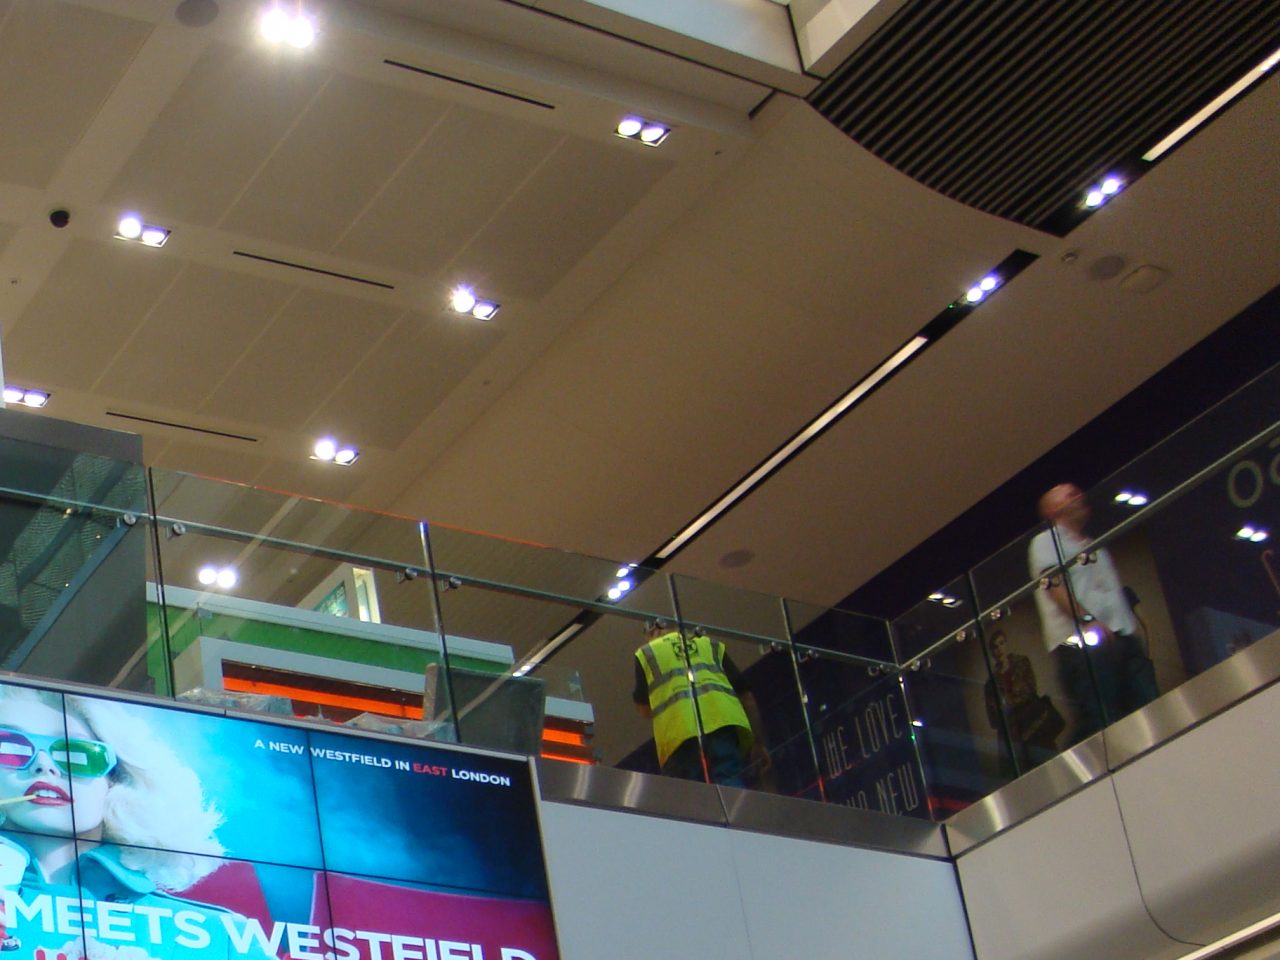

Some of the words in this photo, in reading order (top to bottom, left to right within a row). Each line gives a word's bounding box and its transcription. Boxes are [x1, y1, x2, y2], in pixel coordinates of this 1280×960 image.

[855, 694, 903, 759] LOVE
[254, 739, 265, 749] A
[269, 741, 304, 756] NEW
[310, 747, 392, 768] WESTFIELD
[395, 760, 410, 771] IN
[413, 763, 448, 777] EAST
[451, 768, 511, 787] LONDON
[875, 761, 919, 817] NEW
[4, 889, 211, 949] MEETS
